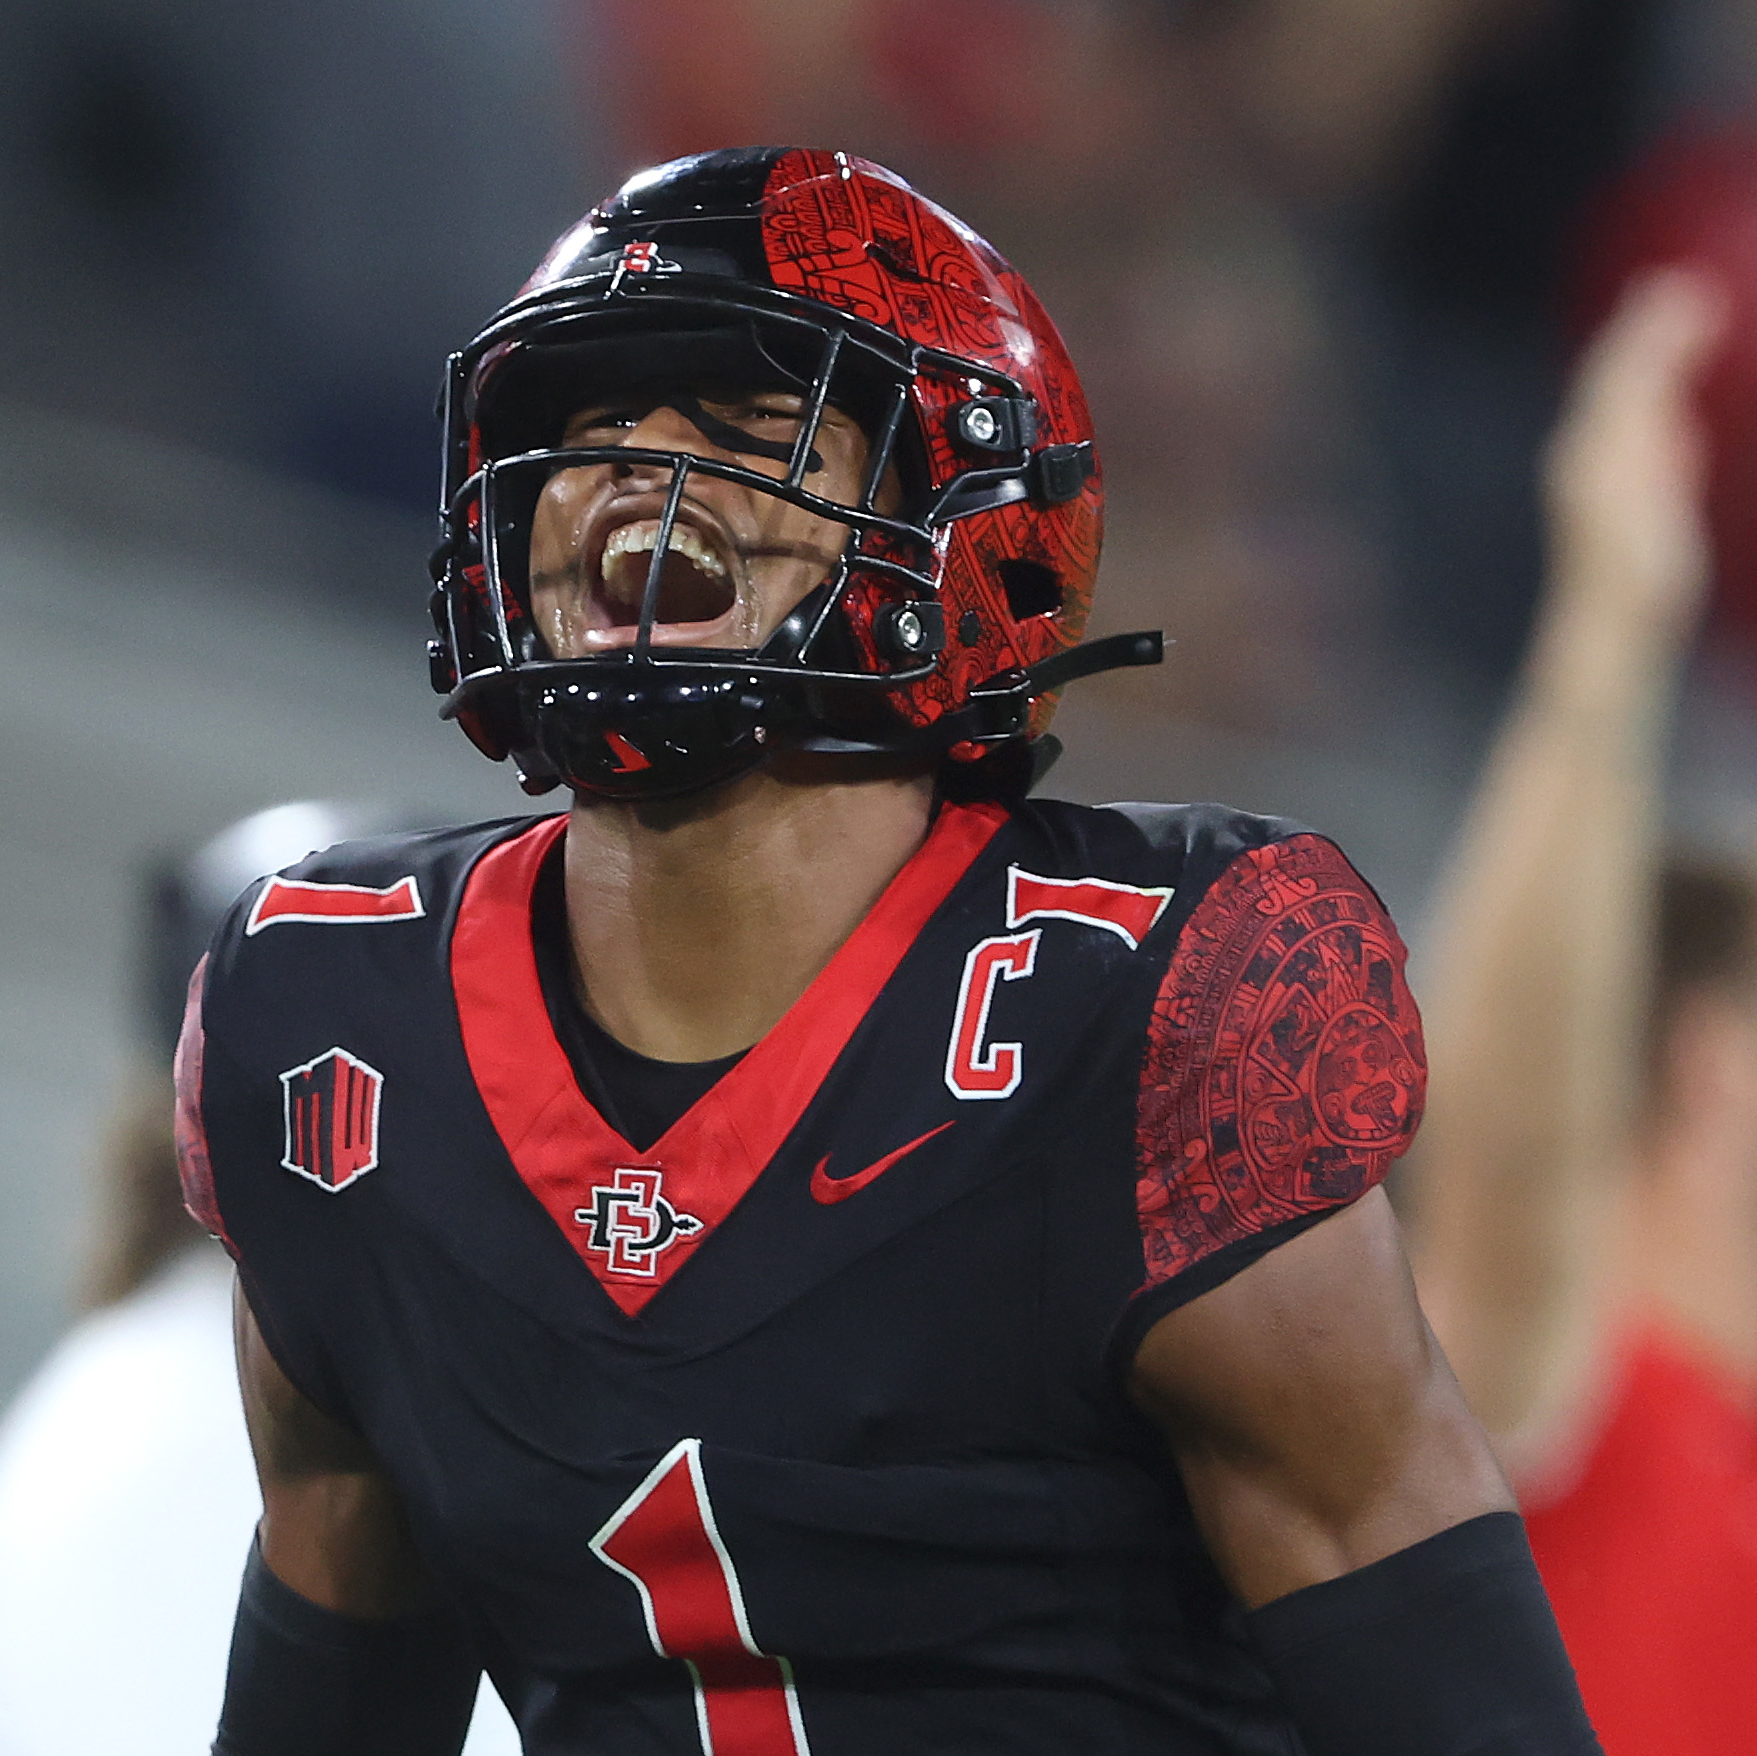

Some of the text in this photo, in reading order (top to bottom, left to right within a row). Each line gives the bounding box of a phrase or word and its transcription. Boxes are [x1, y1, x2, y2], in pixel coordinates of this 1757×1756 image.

[245, 874, 426, 937] 1
[1006, 862, 1175, 951] 1
[945, 928, 1042, 1100] C
